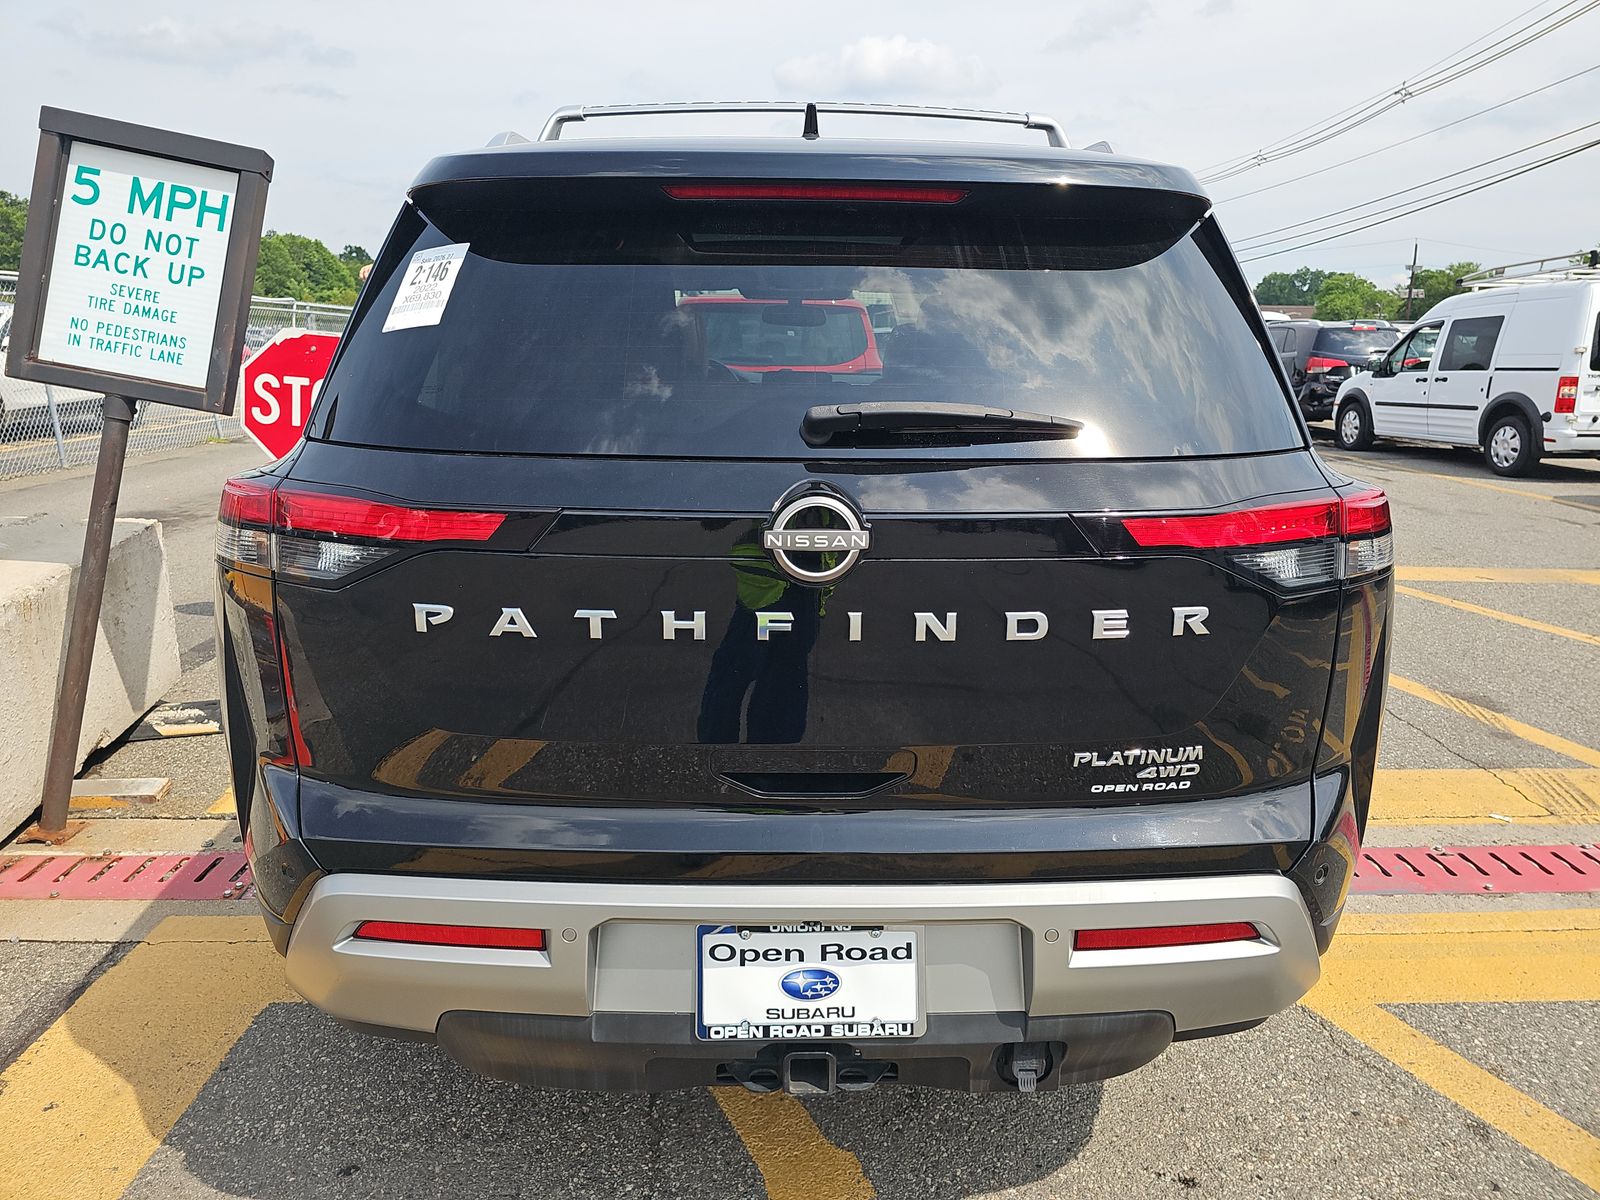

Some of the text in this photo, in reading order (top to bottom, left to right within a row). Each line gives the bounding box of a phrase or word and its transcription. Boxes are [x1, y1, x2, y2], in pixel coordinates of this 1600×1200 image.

[71, 165, 229, 232] 5 MPH
[89, 218, 199, 259] DO NOT
[74, 244, 205, 287] BACK UP
[410, 260, 451, 286] 2:146
[110, 284, 160, 303] SEVERE
[89, 296, 176, 323] TIRE DAMAGE
[70, 317, 186, 349] NO PEDESTRIANS
[68, 334, 183, 364] IN TRAFFIC LANE
[767, 533, 867, 549] NISSAN
[412, 603, 1211, 642] PATHFINDER
[1073, 745, 1203, 768] PLATINUM
[1136, 764, 1200, 779] 4WD
[1090, 781, 1191, 793] OPEN ROAD
[708, 941, 913, 967] Open Road
[765, 1006, 856, 1020] SUBARU
[709, 1023, 912, 1040] OPEN ROAD SUBARU
